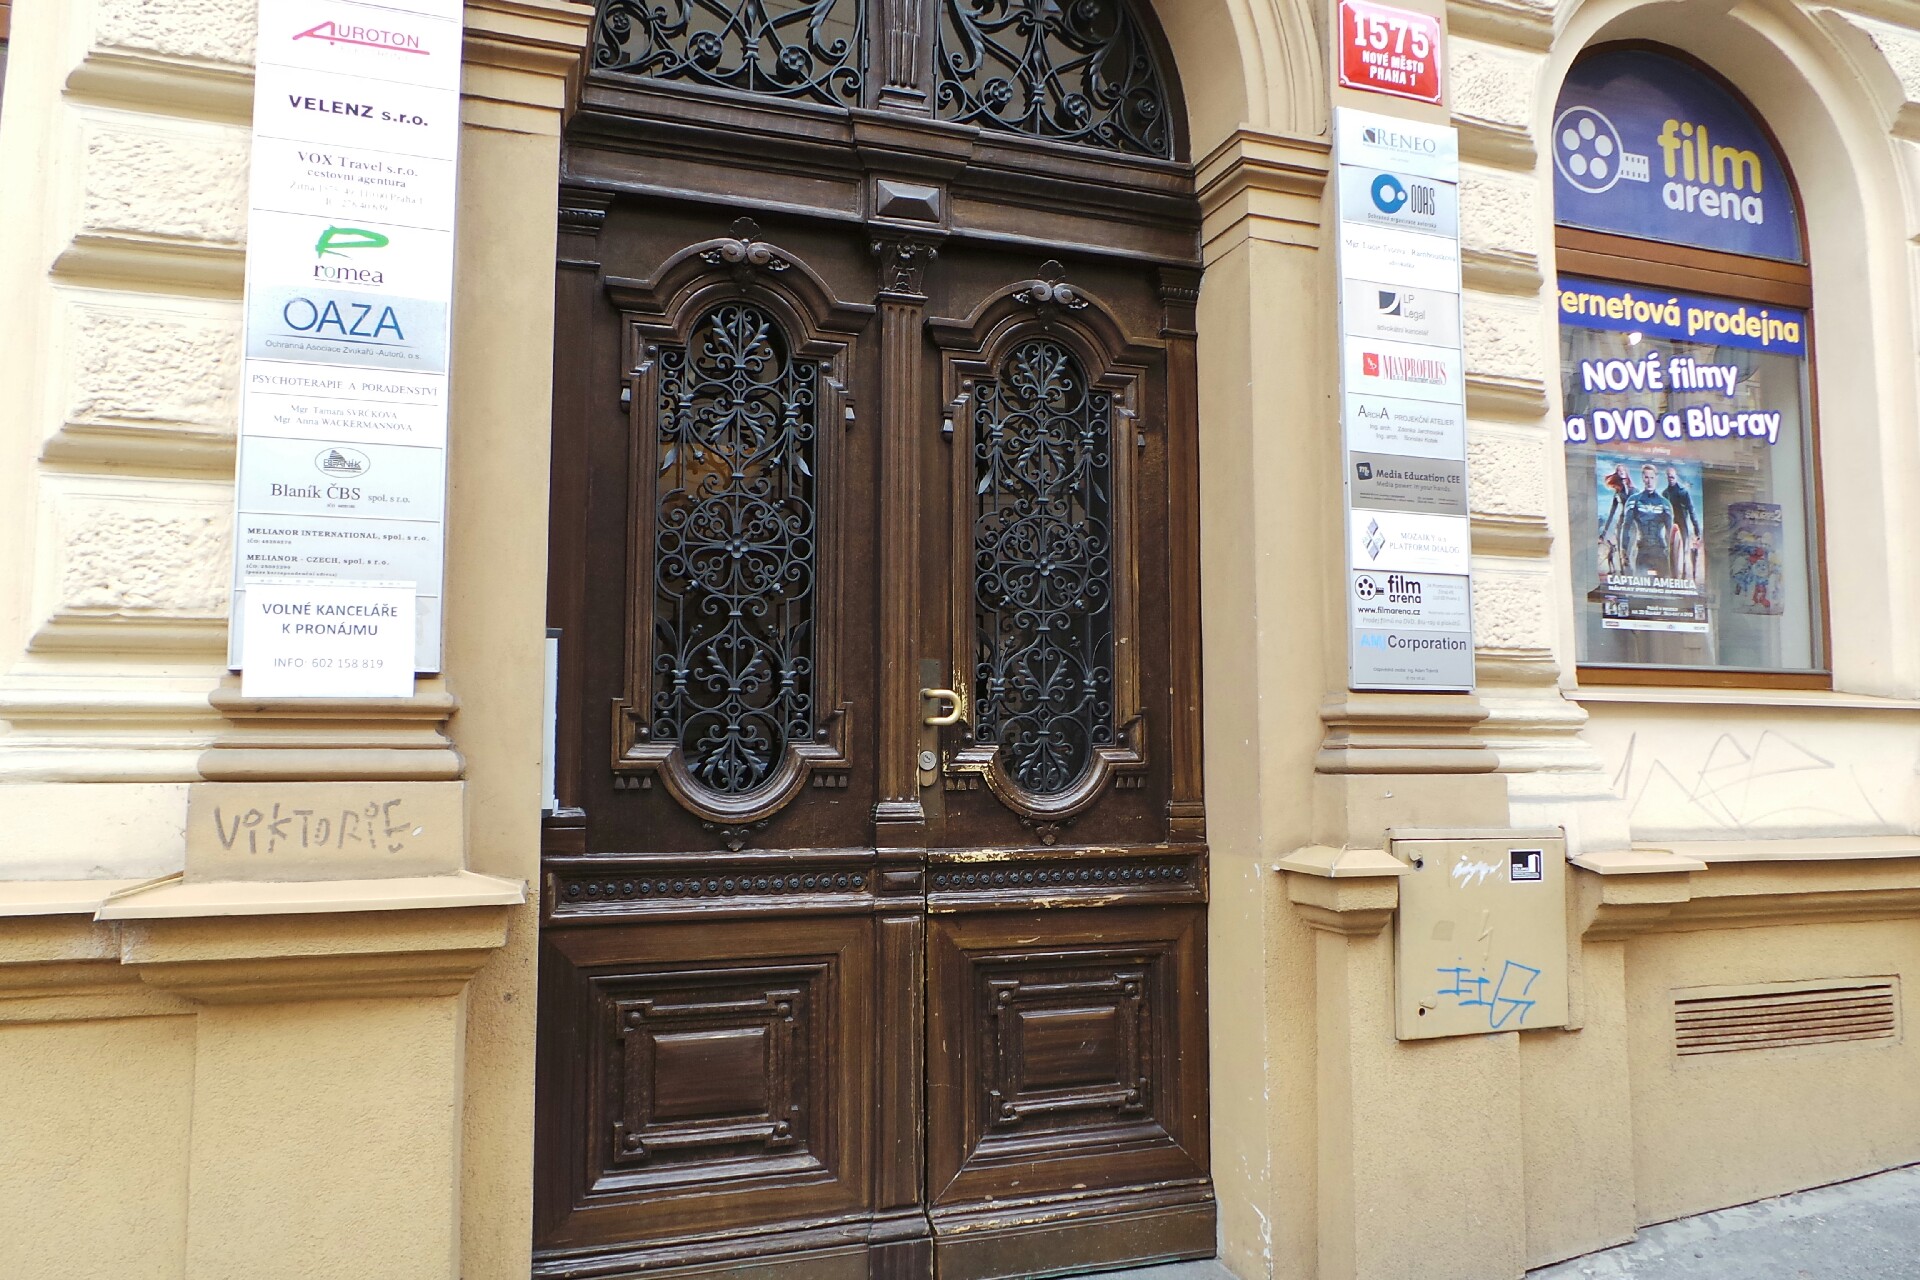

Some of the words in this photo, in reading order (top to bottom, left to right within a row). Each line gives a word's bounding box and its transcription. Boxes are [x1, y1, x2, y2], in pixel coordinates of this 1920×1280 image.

[292, 20, 424, 51] AUROTON
[1354, 9, 1429, 58] 1575
[1362, 50, 1389, 66] NOVÉ
[1391, 55, 1424, 74] MĚSTO
[1369, 65, 1407, 85] PRAHA
[1410, 73, 1416, 87] 1
[288, 94, 374, 119] VELENZ
[381, 111, 429, 126] s.r.o.
[1377, 128, 1436, 153] RENEO
[297, 151, 333, 166] VOX
[338, 156, 382, 172] Travel
[386, 166, 419, 177] s.r.o.
[1657, 118, 1763, 194] film
[357, 175, 407, 188] agentura
[1662, 181, 1764, 225] arena
[313, 264, 384, 284] romea
[283, 297, 405, 340] OAZA
[1403, 308, 1426, 321] Legal
[1557, 290, 1681, 327] ernetová
[1687, 307, 1800, 346] prodejna
[1582, 352, 1663, 391] NOVÉ
[1668, 357, 1738, 396] filmy
[252, 374, 343, 389] PSYCHOTERAPIE
[348, 381, 356, 390] A
[362, 382, 438, 396] PORADENSTVÍ
[1593, 408, 1655, 440] DVD
[1662, 415, 1681, 439] a
[1687, 405, 1780, 444] Blu-ray
[1376, 469, 1402, 479] Media
[1404, 472, 1445, 483] Education
[1447, 475, 1460, 484] CEE
[271, 483, 322, 499] Blaník
[326, 482, 361, 500] ČBS
[247, 528, 299, 536] MELIANOR
[301, 530, 381, 540] INTERNATIONAL,
[1389, 542, 1430, 552] PLATFORM
[1432, 545, 1460, 553] DIALOG
[247, 554, 298, 562] MELIANOR
[1388, 575, 1422, 594] film
[1607, 574, 1651, 586] CAPTAIN
[1653, 577, 1697, 589] AMERICA
[1389, 594, 1422, 604] arena
[262, 602, 312, 615] VOLNÉ
[316, 603, 398, 617] KANCELÁŘE
[1357, 606, 1421, 616] www.filmarena.cz
[282, 623, 291, 634] K
[295, 622, 378, 636] PRONÁJMU
[1387, 635, 1467, 652] Corporation
[311, 658, 333, 668] 602
[338, 659, 358, 668] 158
[362, 659, 383, 669] 819
